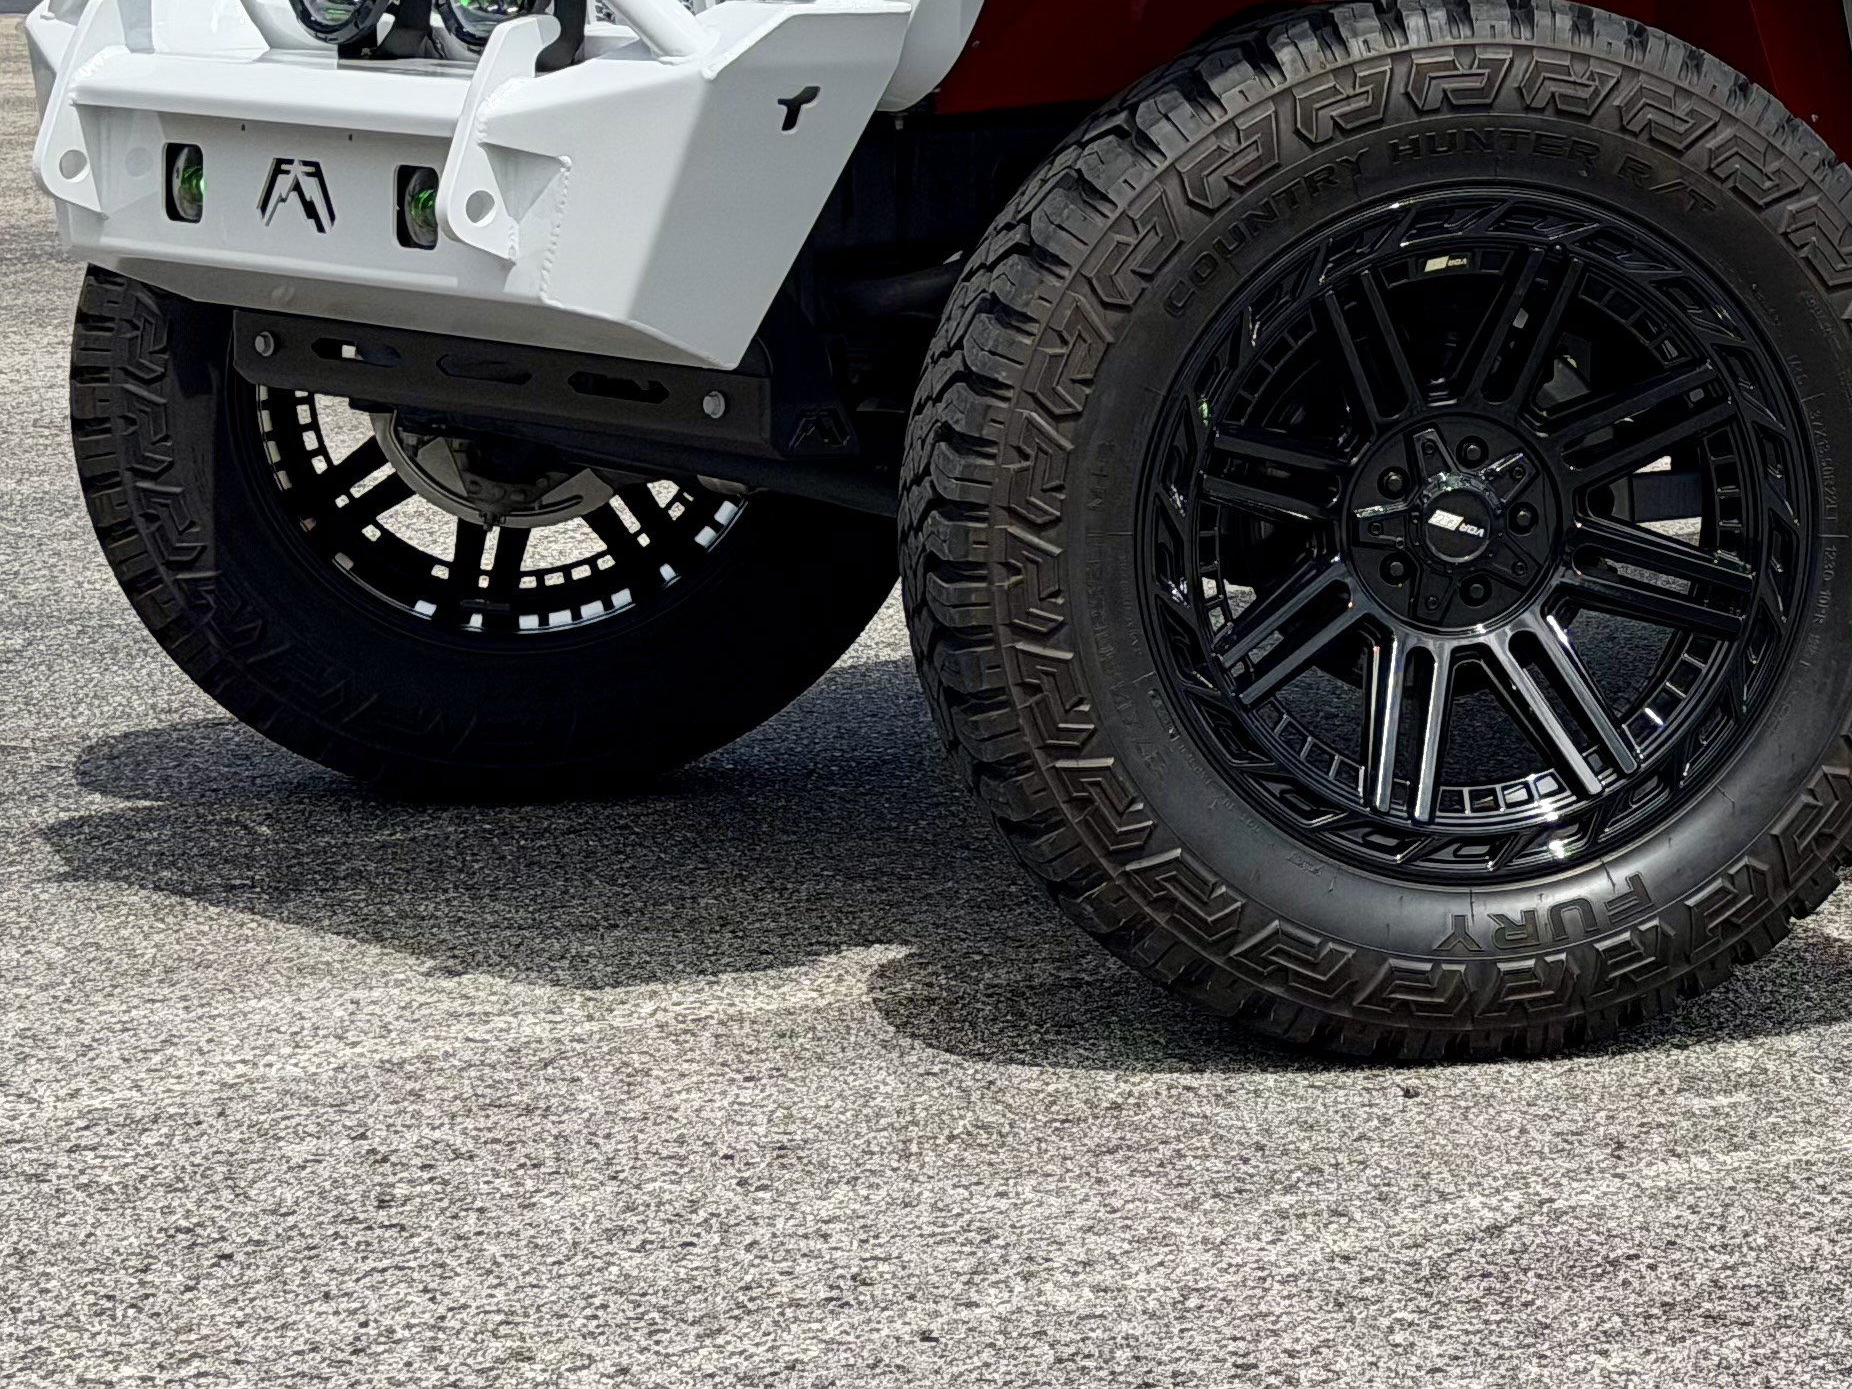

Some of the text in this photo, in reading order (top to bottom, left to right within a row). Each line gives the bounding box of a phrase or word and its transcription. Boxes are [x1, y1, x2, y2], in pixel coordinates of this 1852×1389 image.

[1163, 128, 1719, 318] COUNTRY HUNTER R/T
[1432, 870, 1655, 952] FURY
